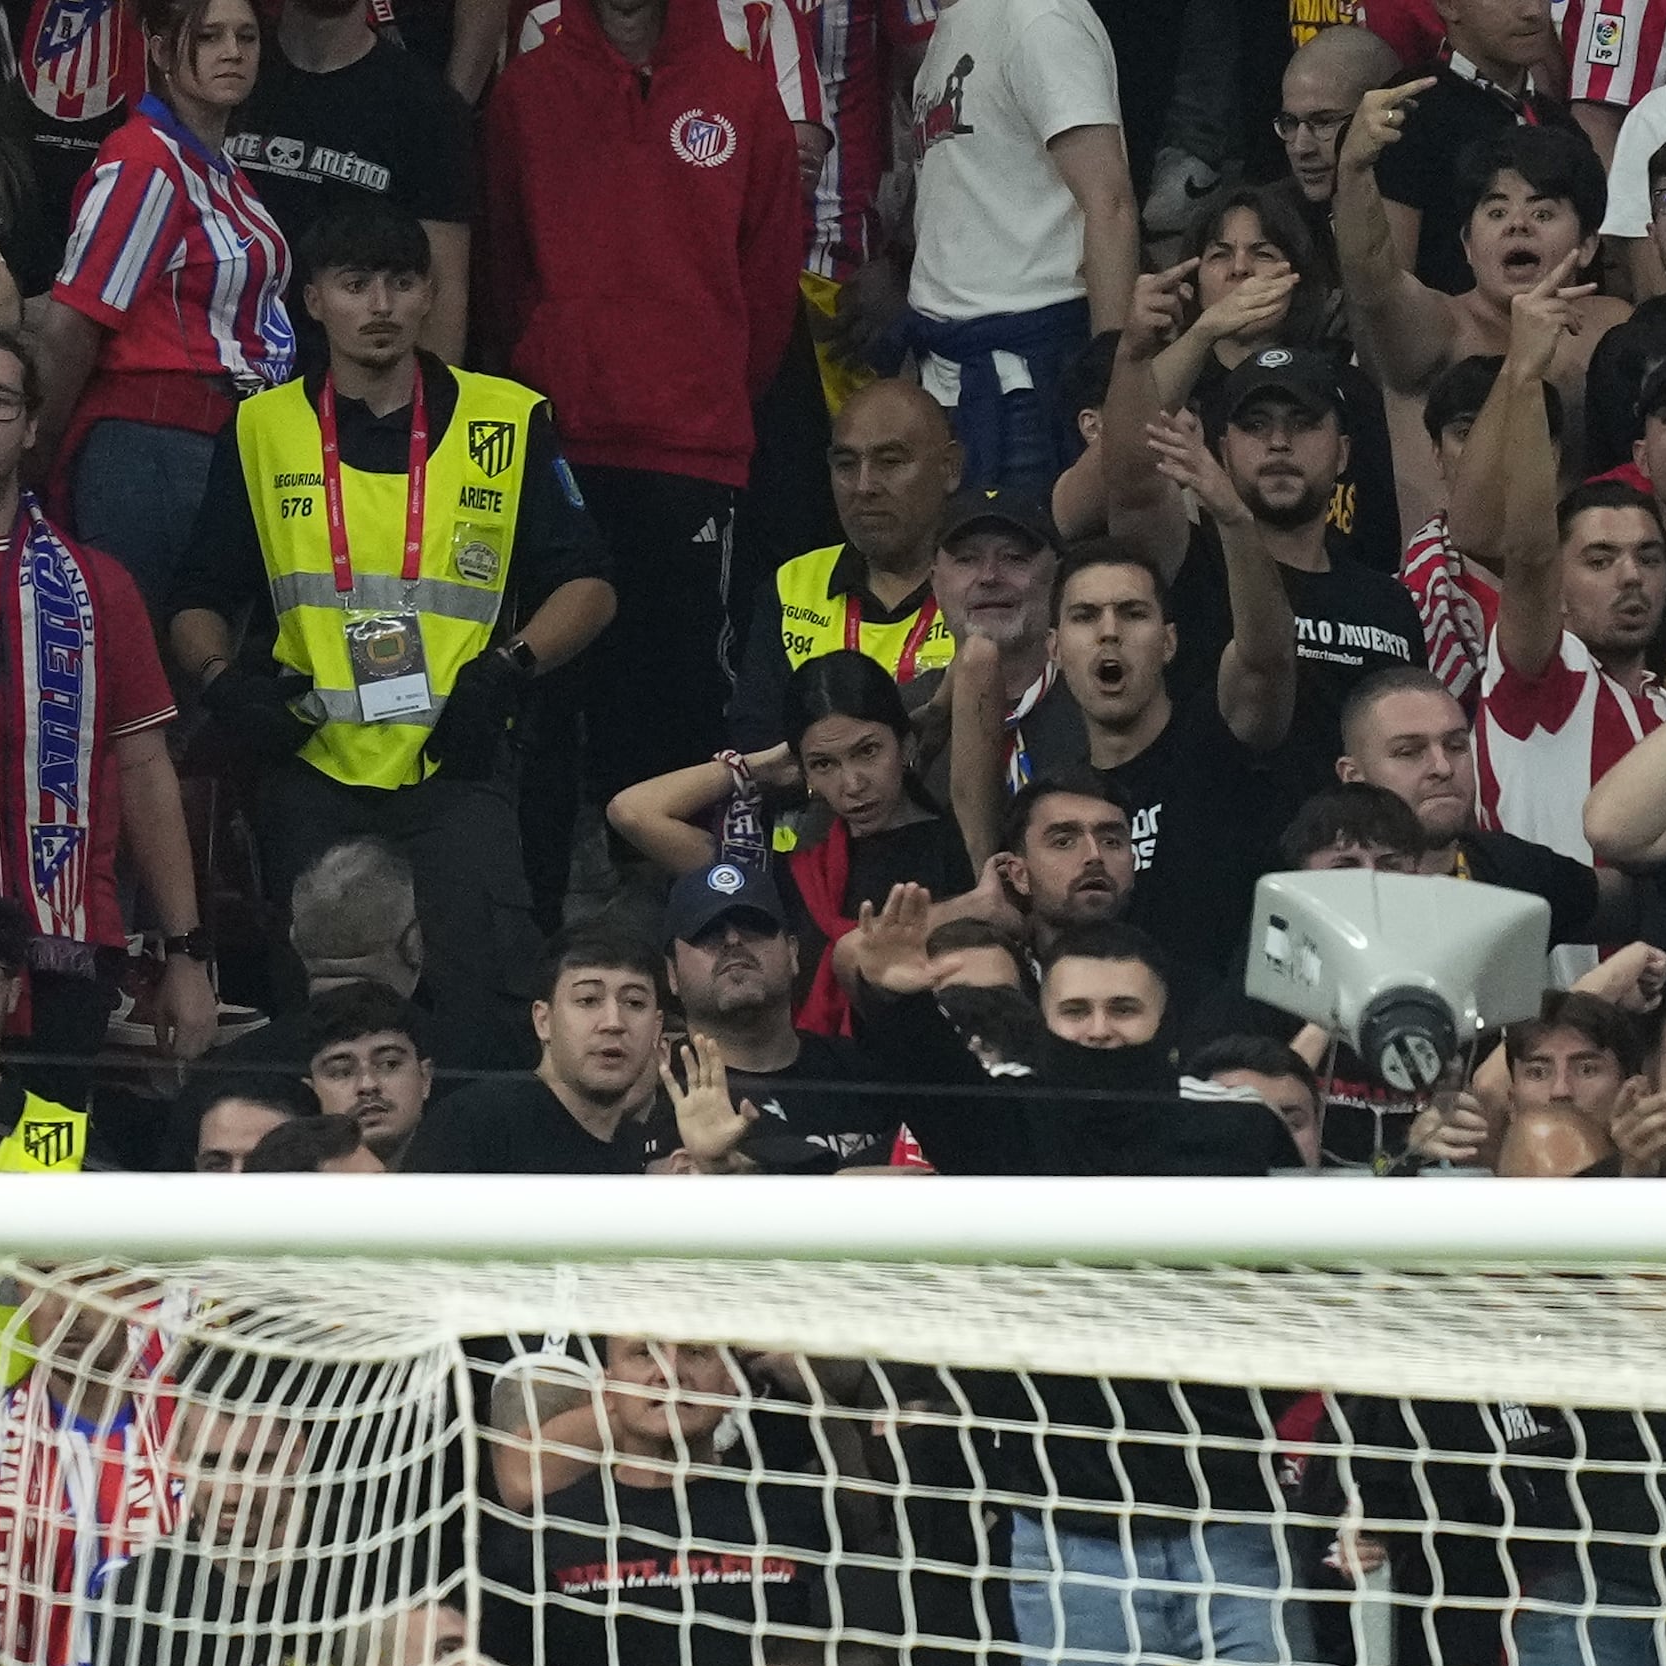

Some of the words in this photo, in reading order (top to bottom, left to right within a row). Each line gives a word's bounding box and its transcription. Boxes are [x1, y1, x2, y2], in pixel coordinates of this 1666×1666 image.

[1596, 49, 1612, 59] LFP
[307, 145, 390, 192] ATLÉTICO
[281, 497, 313, 519] 678
[459, 486, 503, 513] ARIETE
